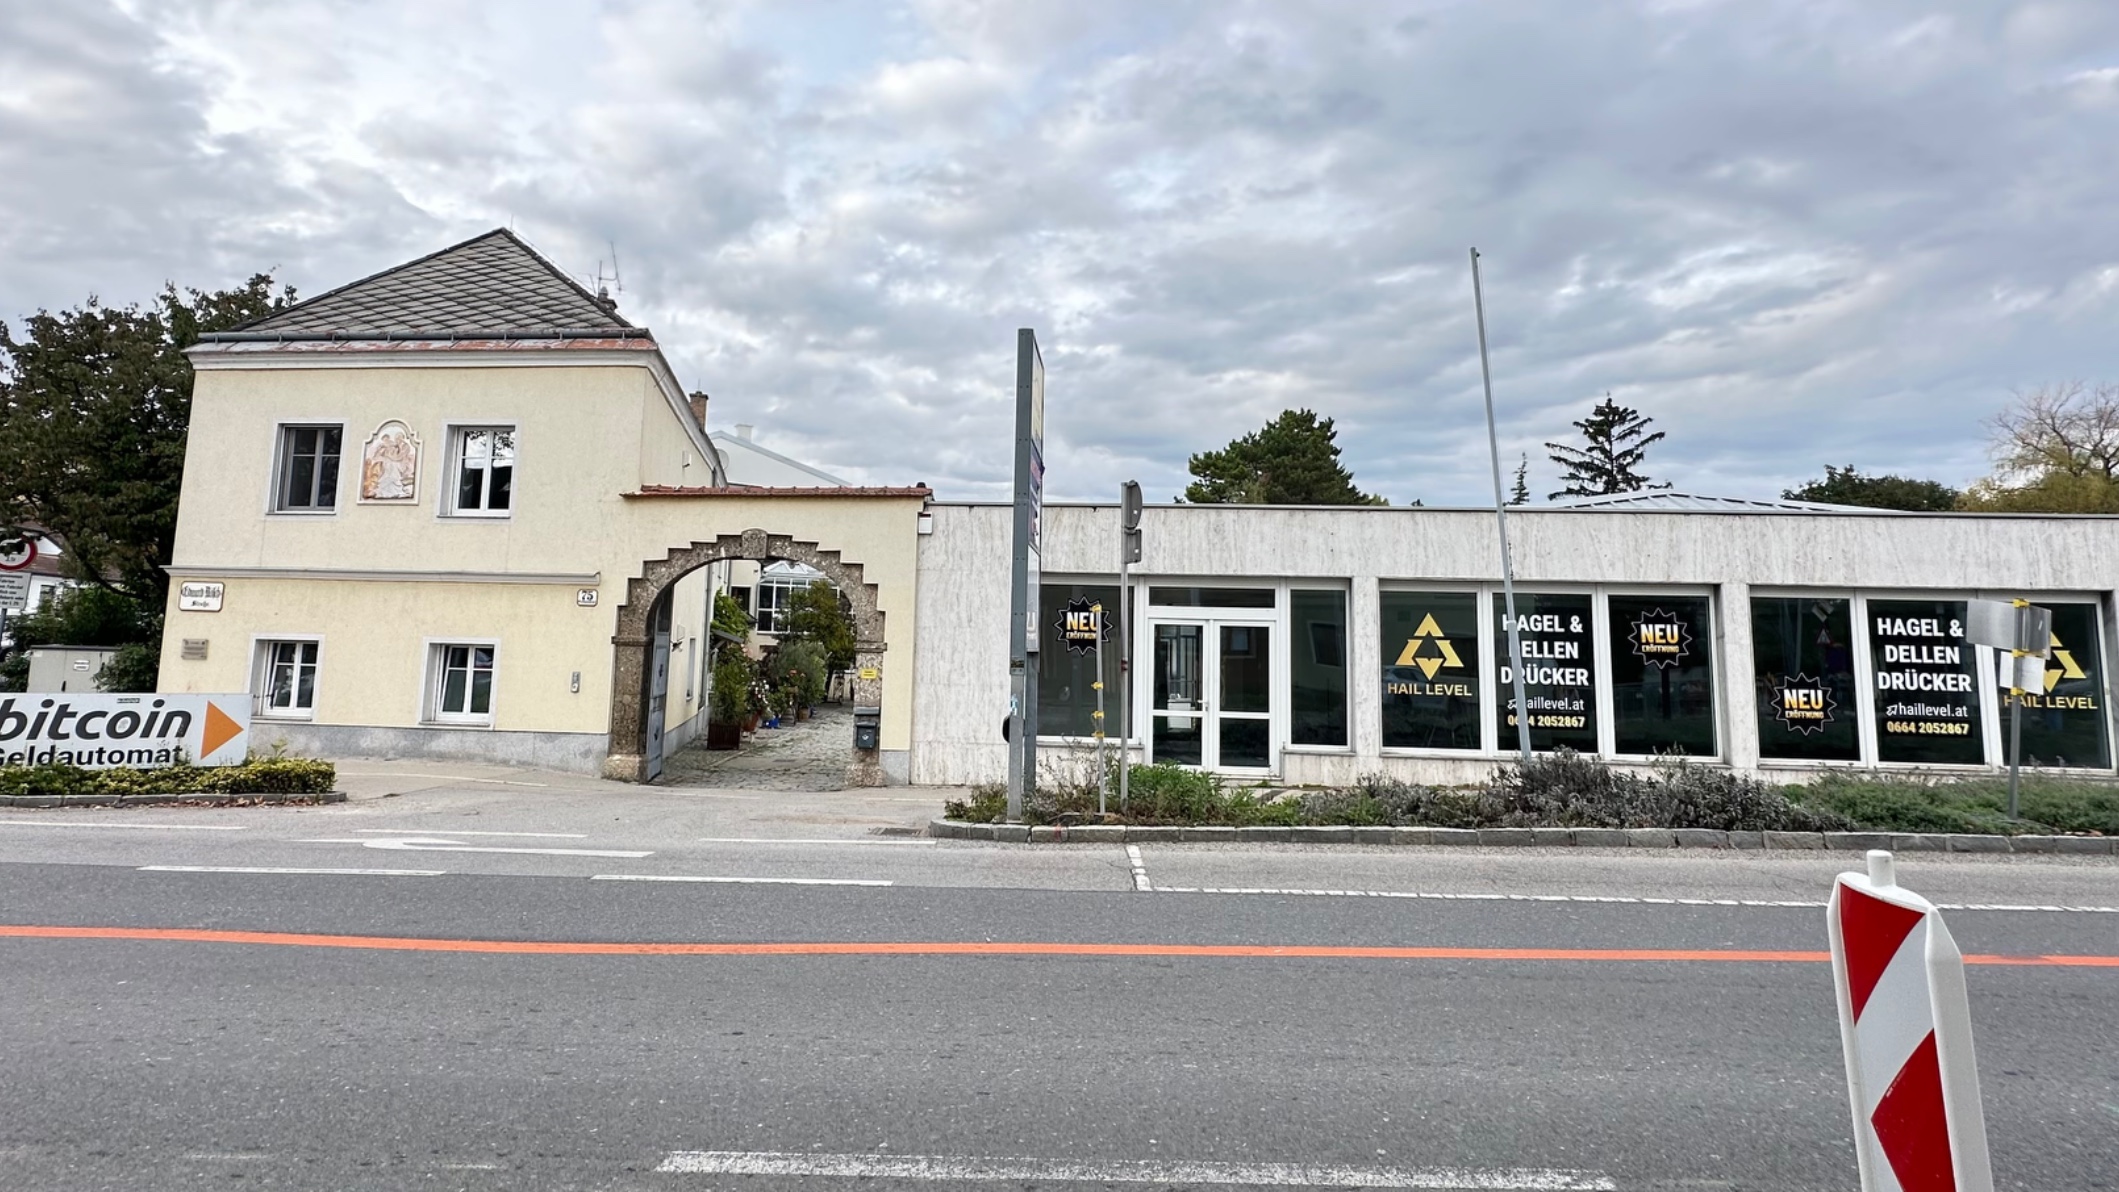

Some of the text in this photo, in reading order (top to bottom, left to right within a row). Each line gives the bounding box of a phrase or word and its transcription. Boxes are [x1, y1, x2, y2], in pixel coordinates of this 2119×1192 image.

[1569, 615, 1584, 633] &
[1876, 617, 1964, 638] HAGEL &
[1640, 623, 1679, 644] NEU
[1509, 640, 1579, 659] ELLEN
[1884, 644, 1960, 665] DELLEN
[1387, 682, 1473, 696] HAIL LEVEL
[1877, 668, 1972, 692] DRÜCKER
[1526, 696, 1585, 711] aillevel.at
[1783, 688, 1823, 710] NEU
[2045, 696, 2098, 710] LEVEL
[1898, 702, 1968, 717] haillevel.at
[0, 698, 192, 742] bitcoin
[1537, 715, 1585, 728] 2052867
[1887, 720, 1969, 735] 0664 2052867
